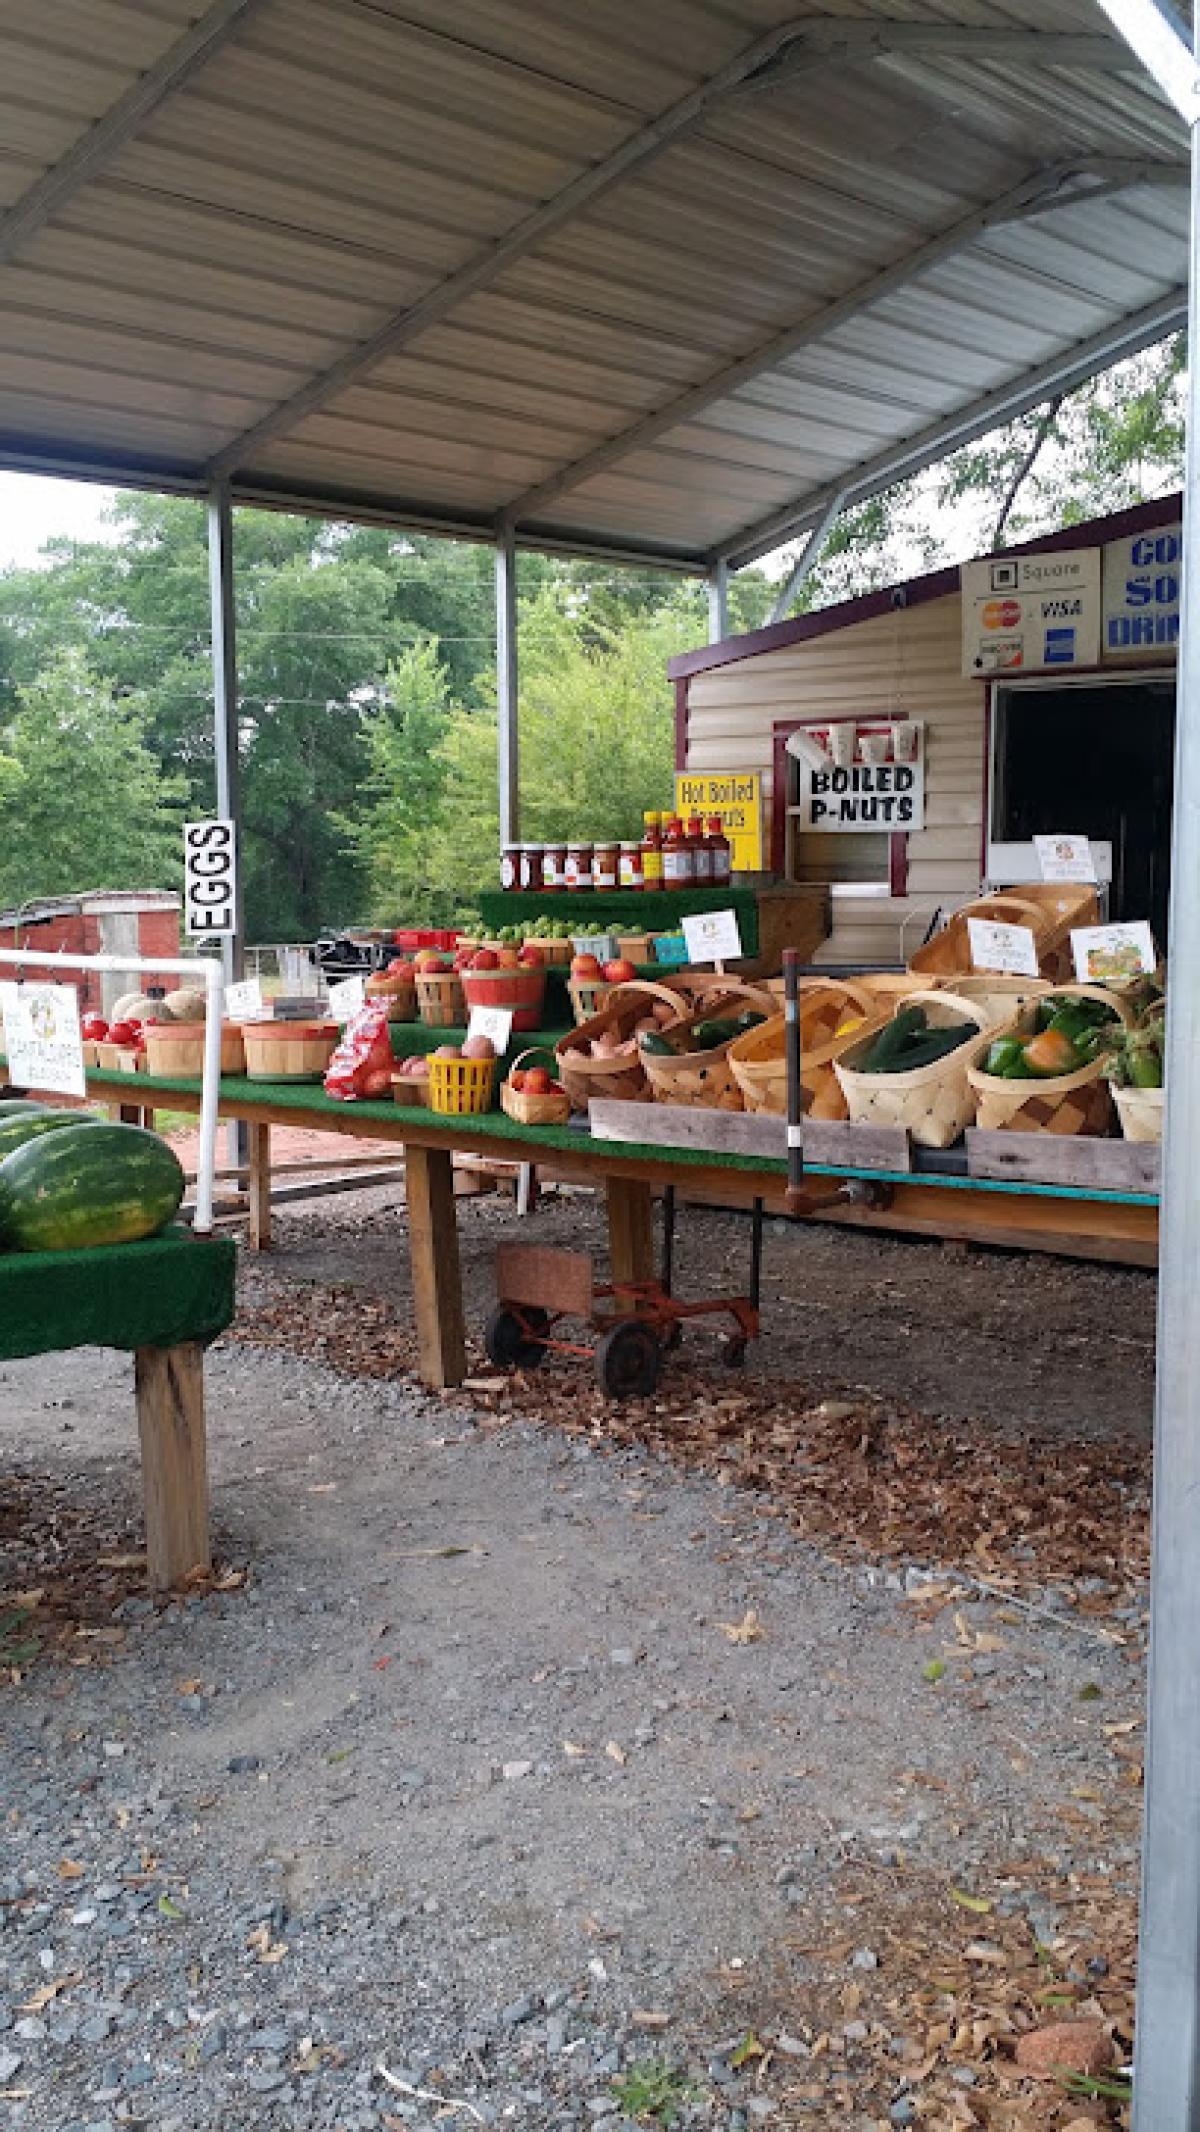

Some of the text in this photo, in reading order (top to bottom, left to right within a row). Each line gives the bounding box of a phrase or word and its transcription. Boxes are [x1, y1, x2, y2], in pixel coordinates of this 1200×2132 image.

[1023, 562, 1080, 583] Square
[1041, 599, 1083, 618] VISA
[682, 776, 753, 803] Hot Boiled
[811, 766, 913, 794] BOILED
[810, 796, 912, 824] P-NUTS
[188, 826, 231, 930] EGGS
